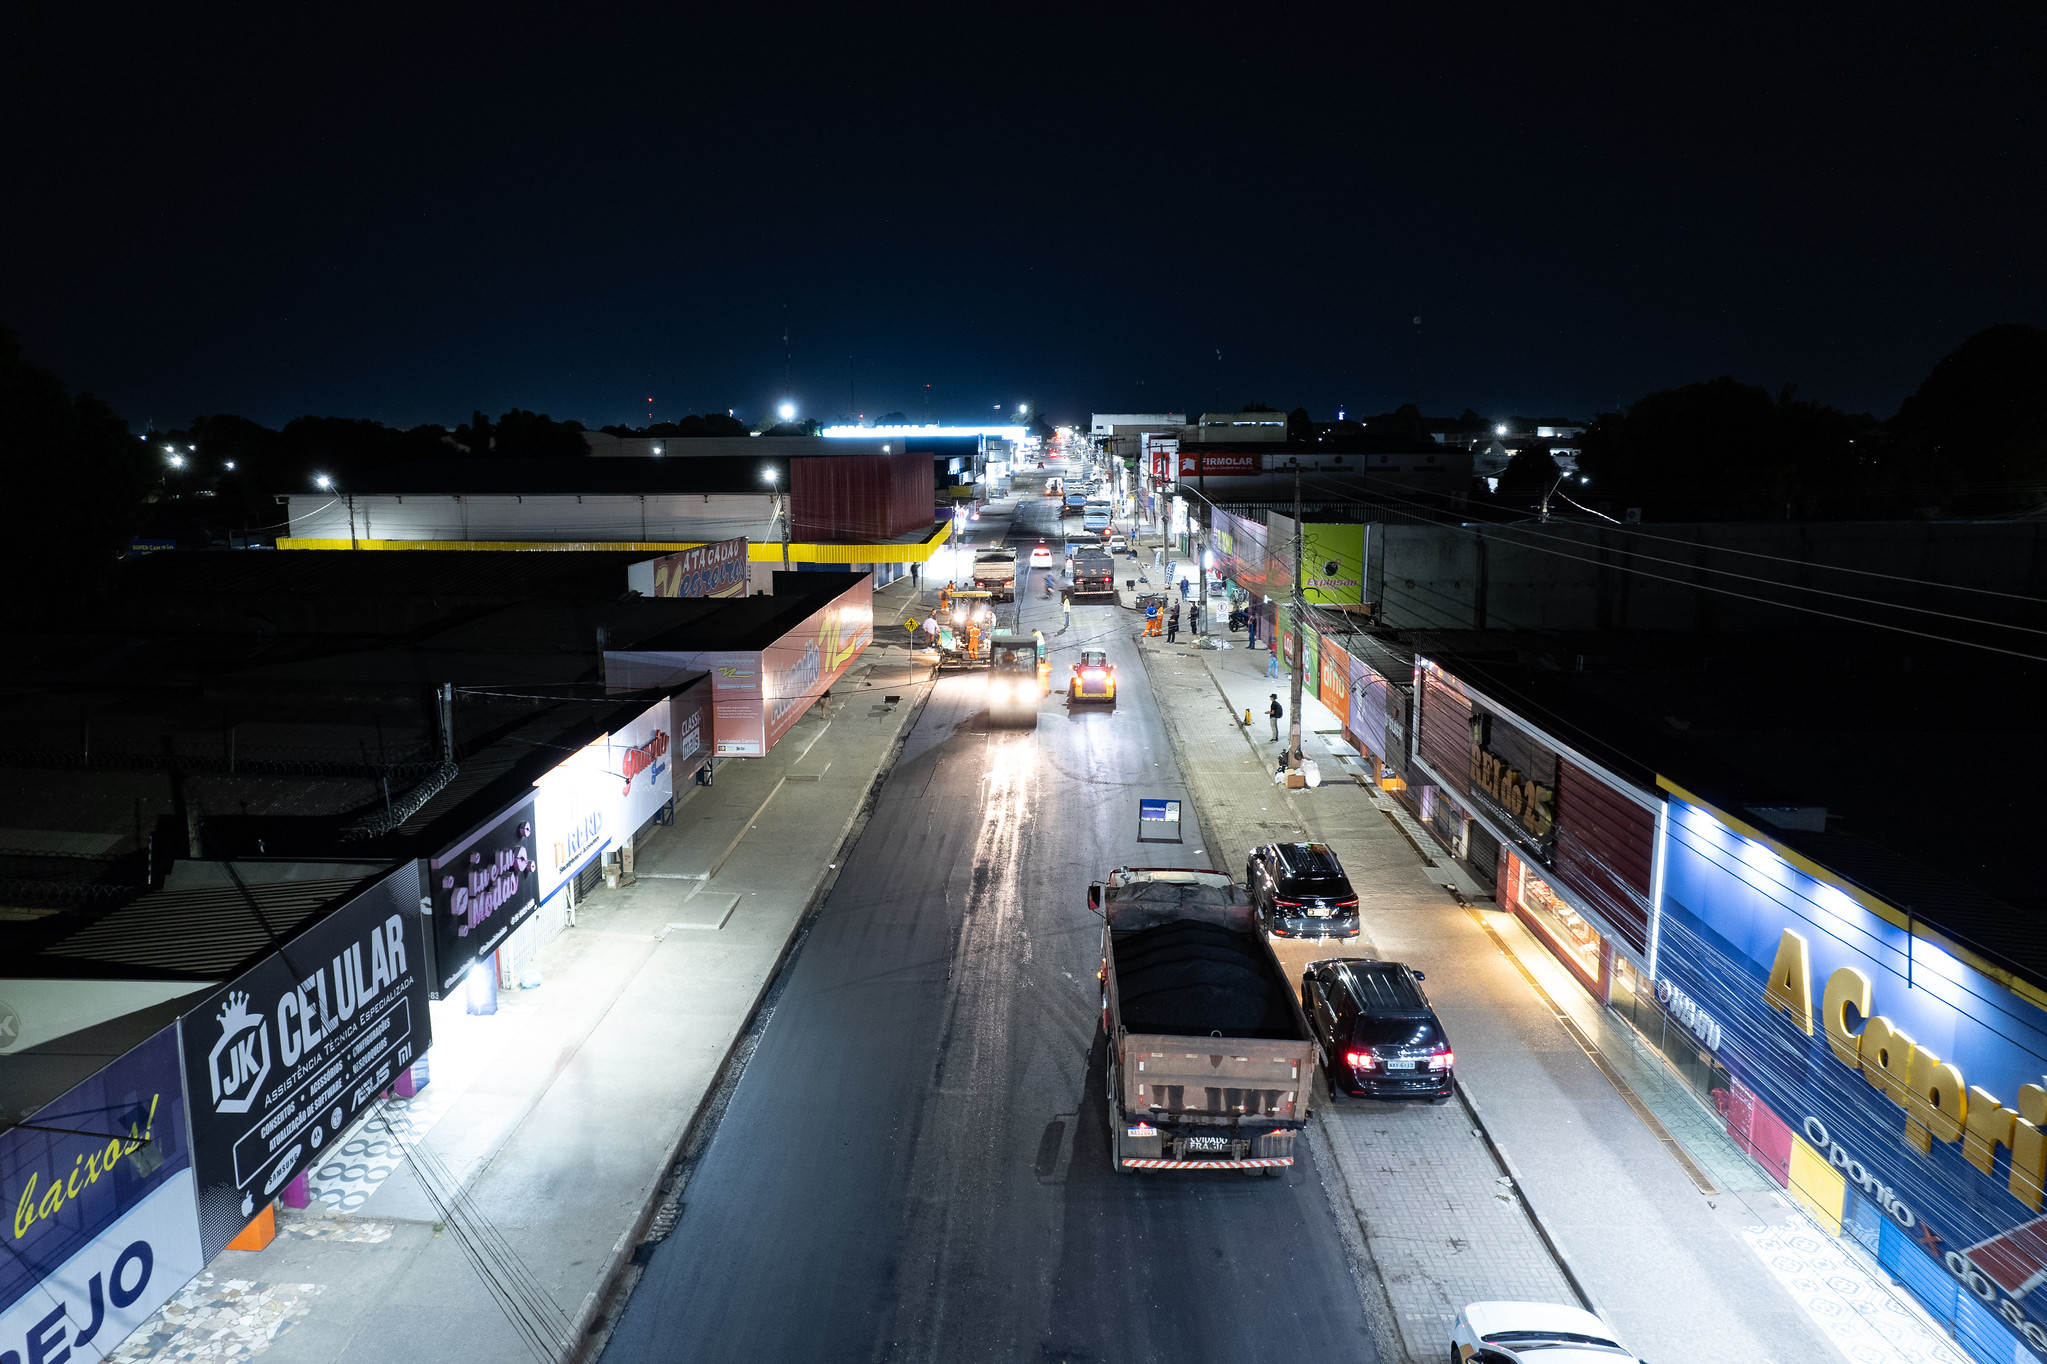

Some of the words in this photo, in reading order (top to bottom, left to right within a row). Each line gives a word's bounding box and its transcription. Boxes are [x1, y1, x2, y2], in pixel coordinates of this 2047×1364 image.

[683, 541, 739, 573] ATACADÃO
[468, 872, 519, 929] Modas
[277, 914, 408, 1068] CELULAR
[1763, 928, 1814, 1037] A
[222, 1033, 259, 1096] JK
[261, 1101, 296, 1139] CONSERTOS
[310, 1060, 343, 1097] ACESSÓRIOS
[269, 1111, 306, 1152] ATUALIZAÇÃO
[306, 1105, 315, 1119] DE
[314, 1078, 343, 1111] SOFTWARE
[14, 1094, 160, 1239] baixos!
[268, 1154, 299, 1186] SAMSUNG
[1804, 1116, 1829, 1148] O
[1829, 1141, 1915, 1228] ponto
[1945, 1251, 1996, 1302] do
[0, 1240, 154, 1364] EJO
